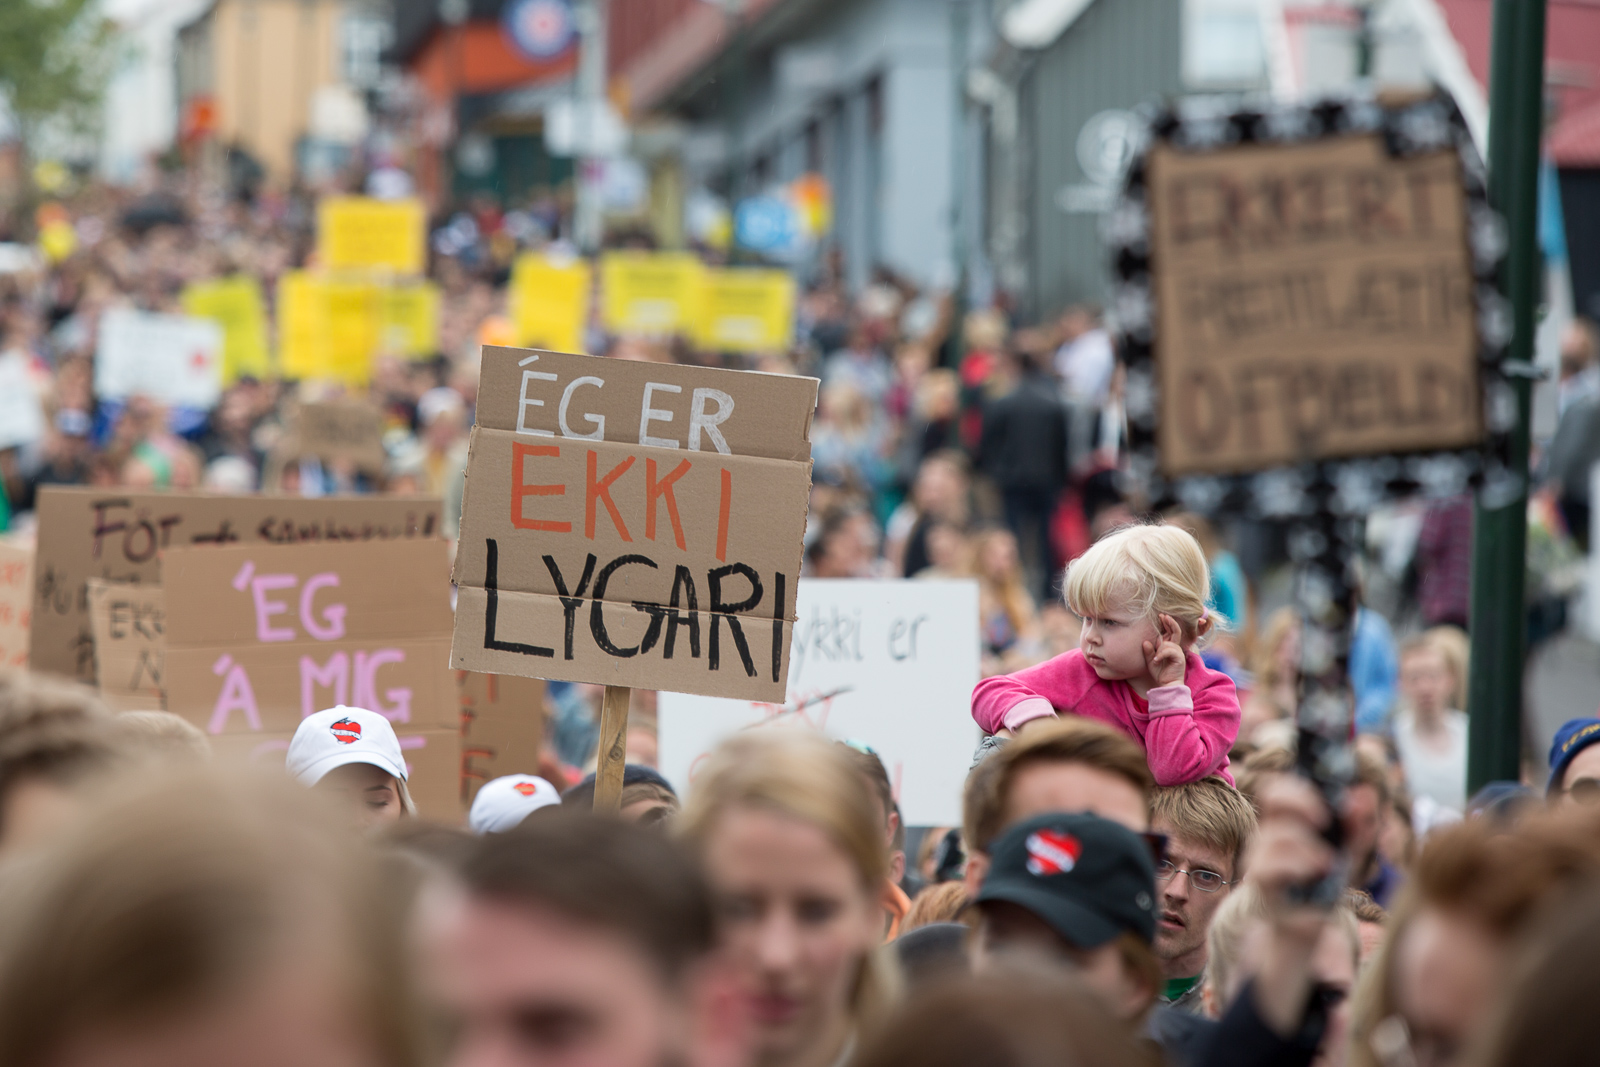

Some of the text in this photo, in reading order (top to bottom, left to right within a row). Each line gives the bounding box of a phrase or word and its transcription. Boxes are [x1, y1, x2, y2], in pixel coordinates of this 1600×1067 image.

[516, 354, 736, 456] ÉG ER
[510, 441, 732, 564] EKKI
[232, 560, 348, 643] ÉG
[483, 537, 787, 684] LYGARI
[887, 613, 931, 663] er
[208, 652, 262, 734] Á
[299, 648, 412, 724] MIG
